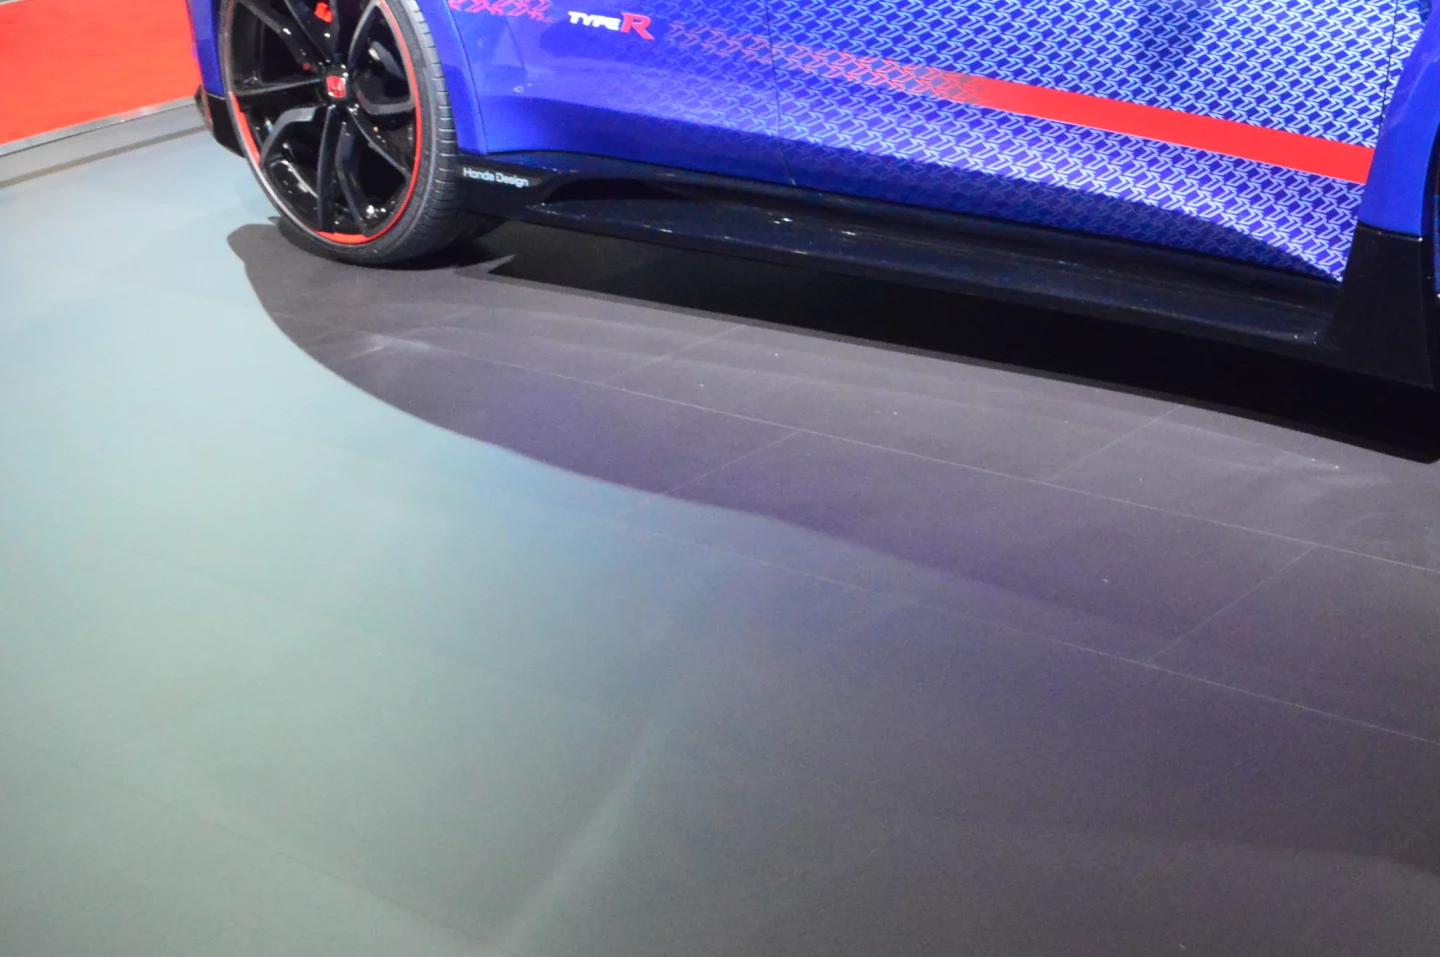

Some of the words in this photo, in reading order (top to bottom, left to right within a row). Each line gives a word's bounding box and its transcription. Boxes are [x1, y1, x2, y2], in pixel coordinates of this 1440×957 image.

[568, 10, 621, 31] TYPE
[620, 11, 655, 40] R
[463, 167, 495, 181] Honda
[495, 172, 529, 188] Design
